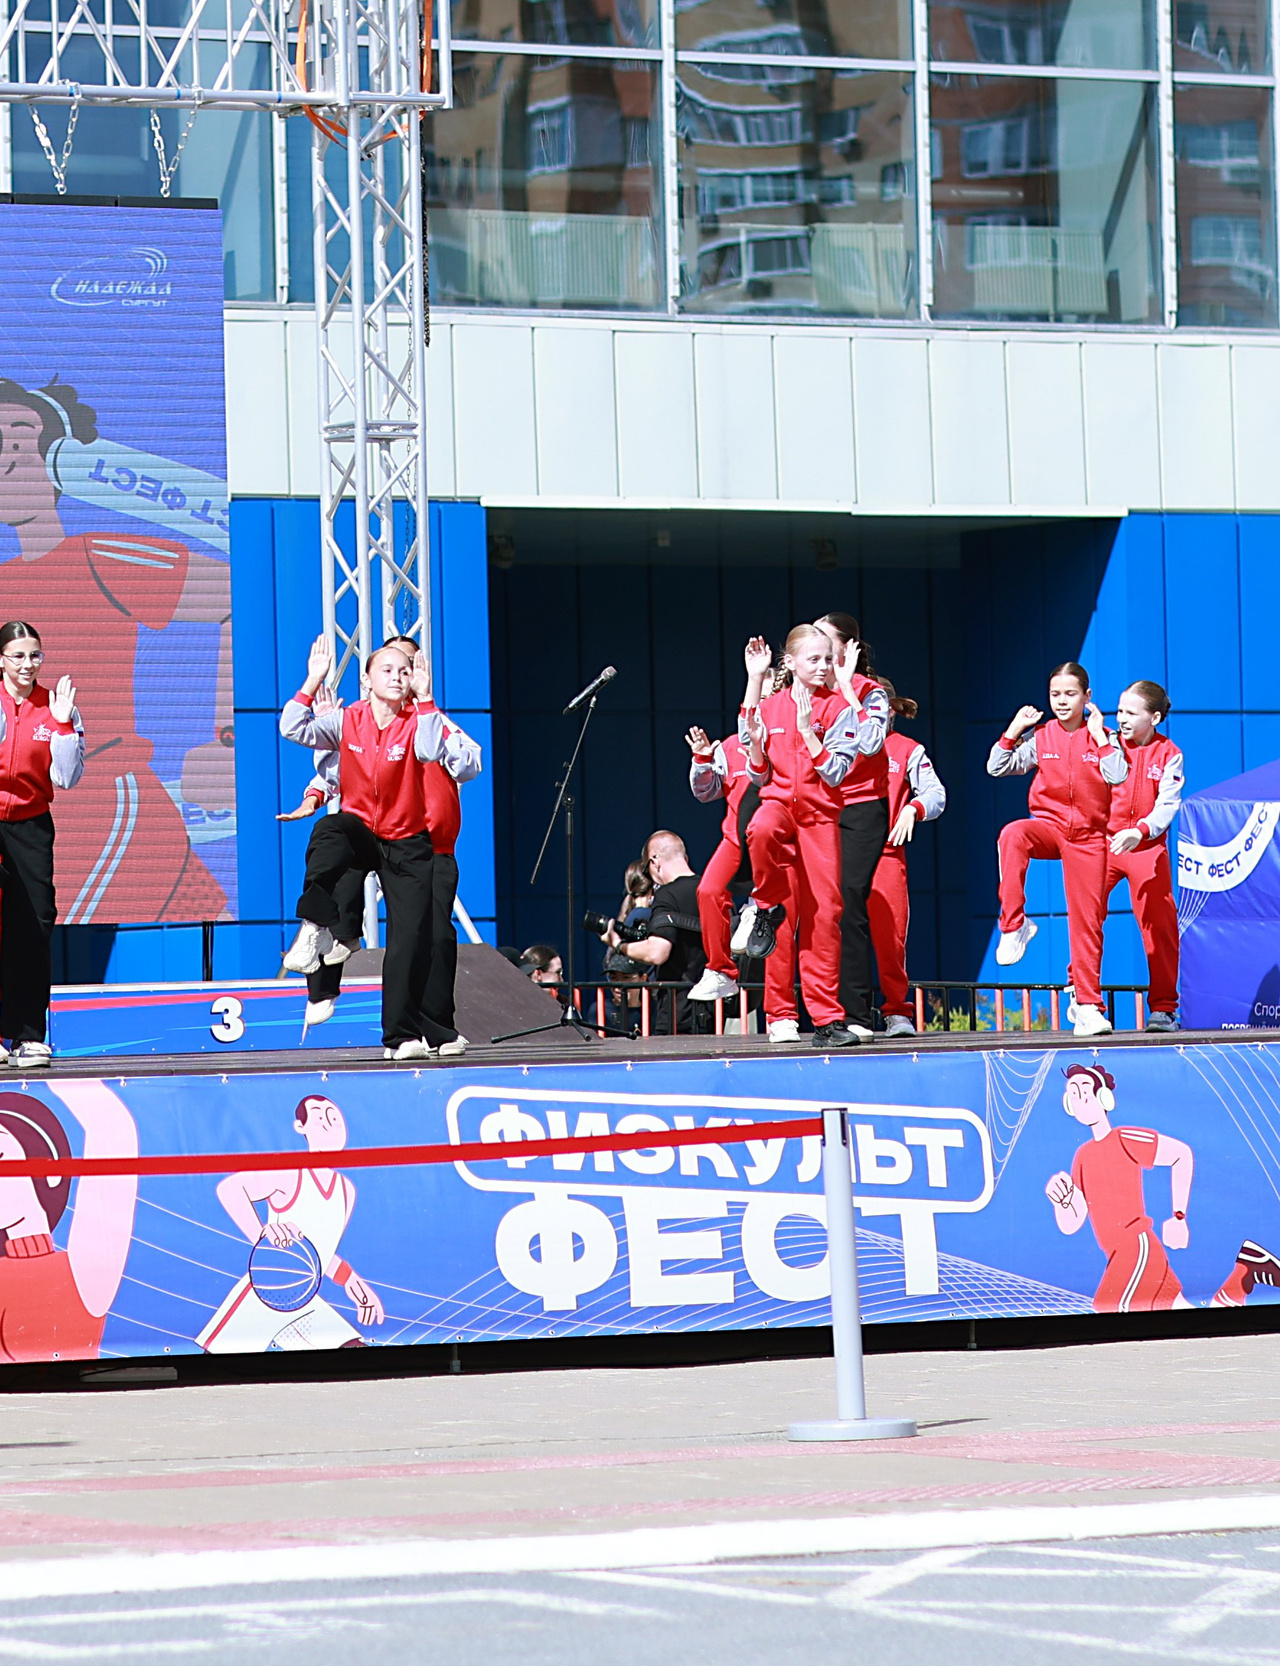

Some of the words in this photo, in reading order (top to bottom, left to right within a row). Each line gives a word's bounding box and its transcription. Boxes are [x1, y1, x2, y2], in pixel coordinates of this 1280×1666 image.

[121, 299, 168, 307] СУРГУТ
[88, 458, 187, 511] ФЕСТ
[1208, 851, 1241, 878] ФЕСТ
[210, 995, 245, 1044] 3
[495, 1188, 940, 1311] ФЕСТ
